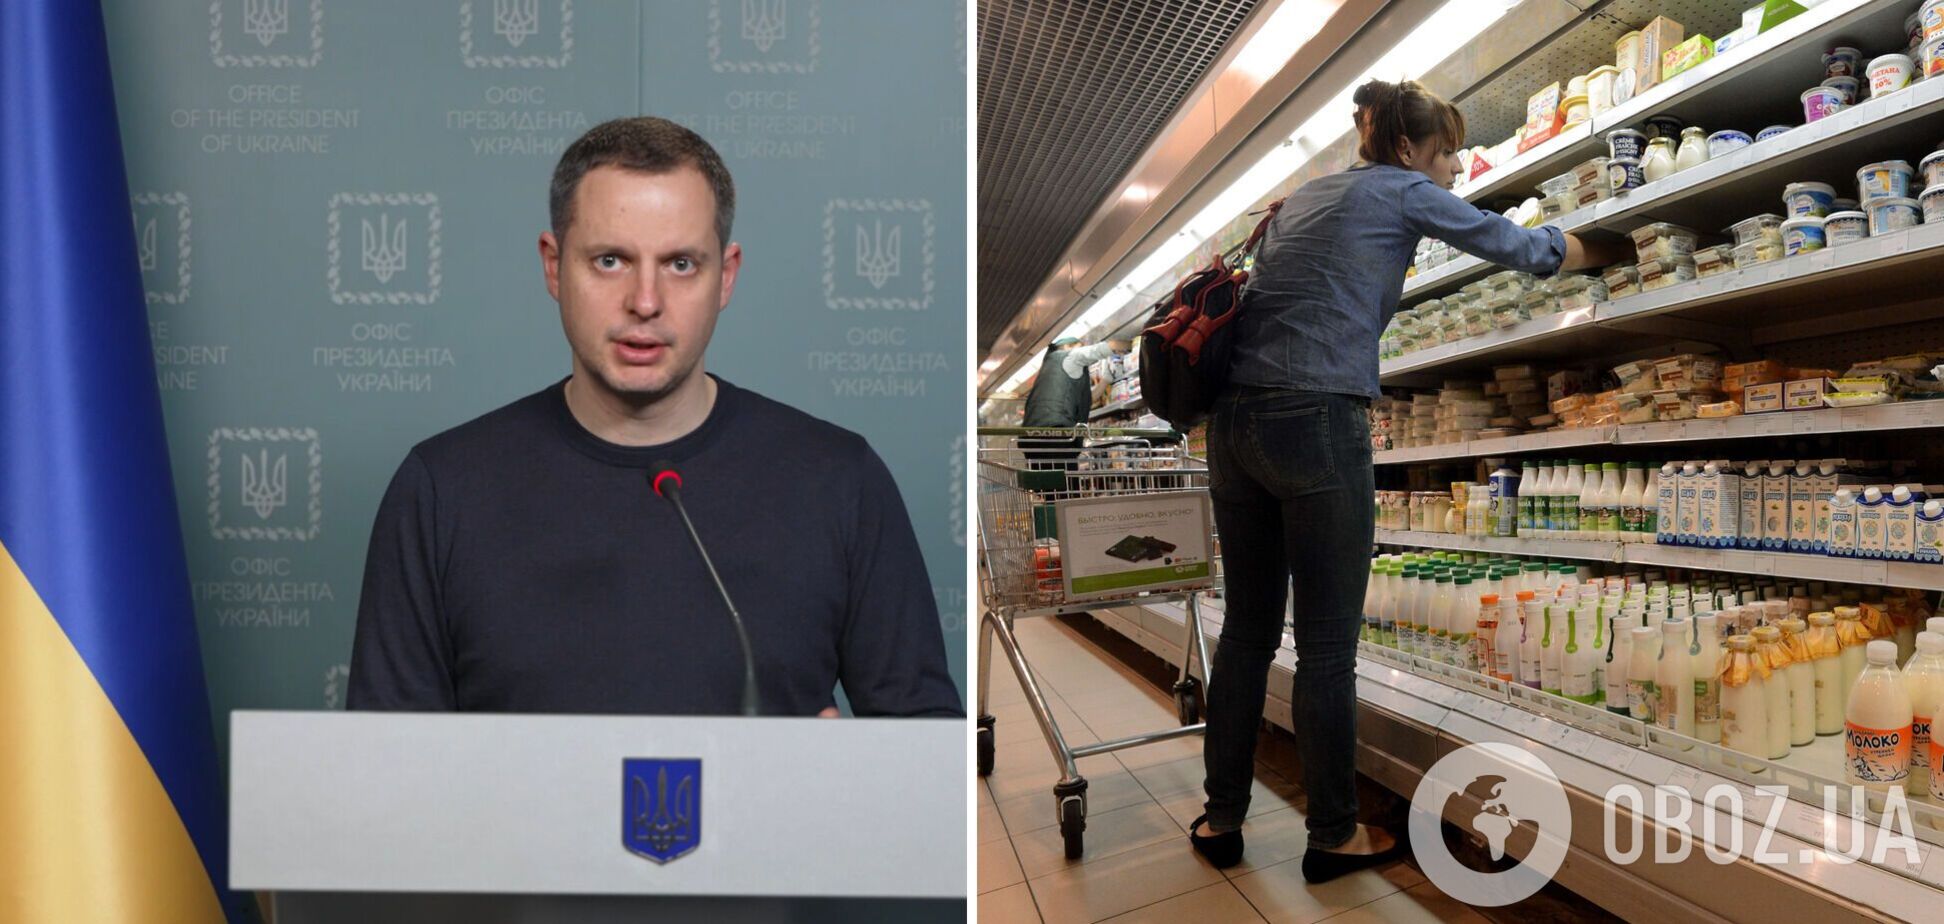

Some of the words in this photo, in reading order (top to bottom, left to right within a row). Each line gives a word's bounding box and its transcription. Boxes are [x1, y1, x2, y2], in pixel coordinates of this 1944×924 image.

[228, 84, 301, 104] OFFICE
[485, 86, 546, 105] ОФІС
[725, 90, 798, 111] OFFICE
[171, 109, 201, 129] OF
[207, 109, 244, 129] THE
[249, 109, 361, 129] PRESIDENT
[447, 111, 588, 132] ПРЕЗИДЕНТА
[705, 115, 743, 135] THE
[748, 115, 857, 135] PRESIDENT
[201, 134, 232, 155] OF
[239, 134, 330, 155] UKRAINE
[470, 133, 566, 156] УКРАЇНИ
[735, 140, 826, 160] UKRAINE
[352, 323, 412, 341] ОФІС
[847, 327, 906, 346] ОФІС
[313, 347, 455, 369] ПРЕЗИДЕНТА
[807, 351, 949, 373] ПРЕЗИДЕНТА
[337, 370, 431, 392] УКРАЇНИ
[831, 376, 926, 398] УКРАЇНИ
[231, 557, 291, 576] ОФІС
[192, 583, 334, 603] ПРЕЗИДЕНТА
[216, 606, 310, 628] УКРАЇНИ
